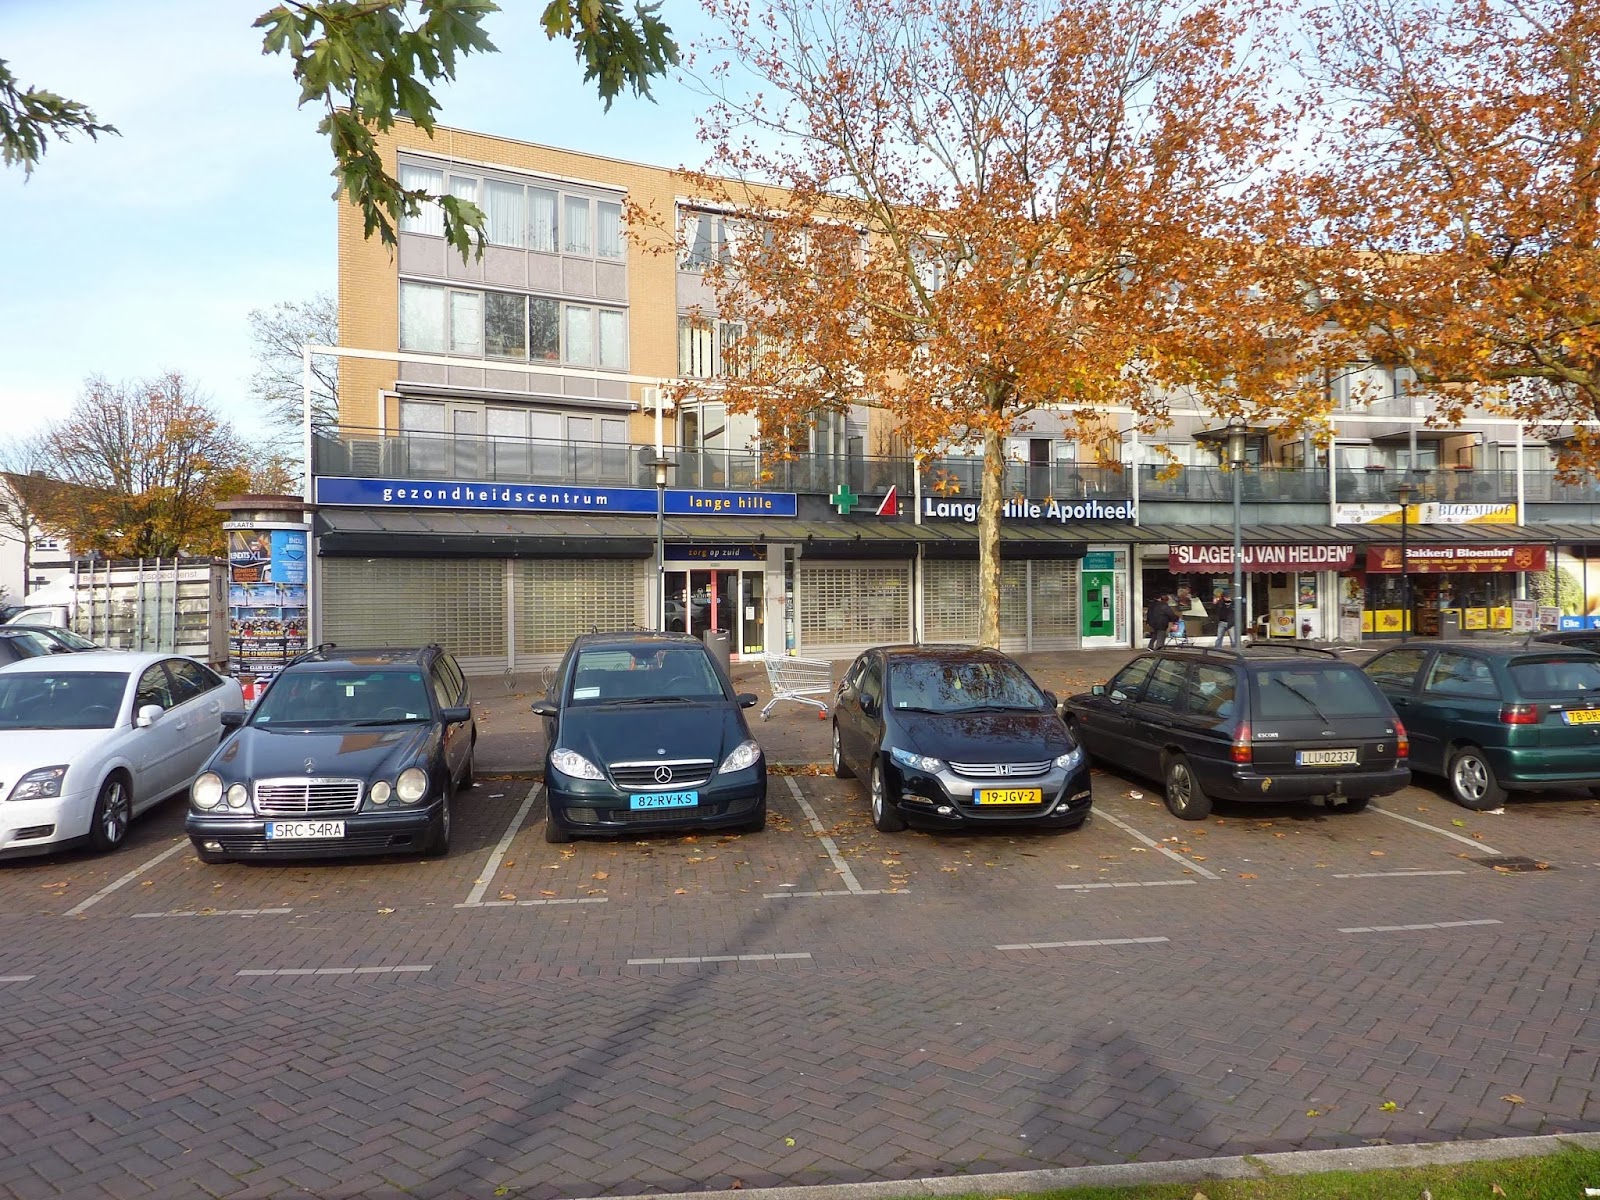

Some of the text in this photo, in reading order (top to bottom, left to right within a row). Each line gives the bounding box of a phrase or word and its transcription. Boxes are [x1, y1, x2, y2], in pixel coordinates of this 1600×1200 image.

[383, 487, 608, 504] gezondheidscentrum
[690, 495, 772, 511] lange hille
[925, 498, 981, 522] Lang
[1047, 500, 1137, 523] Apotheek
[1439, 504, 1512, 516] BLOEMHOF
[688, 548, 740, 557] zorg op zuid
[1256, 545, 1285, 563] VAN
[1405, 547, 1514, 559] Bakkerij Bloemhof
[1563, 619, 1580, 628] Elke
[1302, 751, 1356, 764] LLU 02337
[638, 793, 692, 807] 82-RV-KS
[986, 791, 1036, 803] 19-JGV-2
[275, 824, 304, 837] SRC
[308, 823, 342, 836] 54RA
